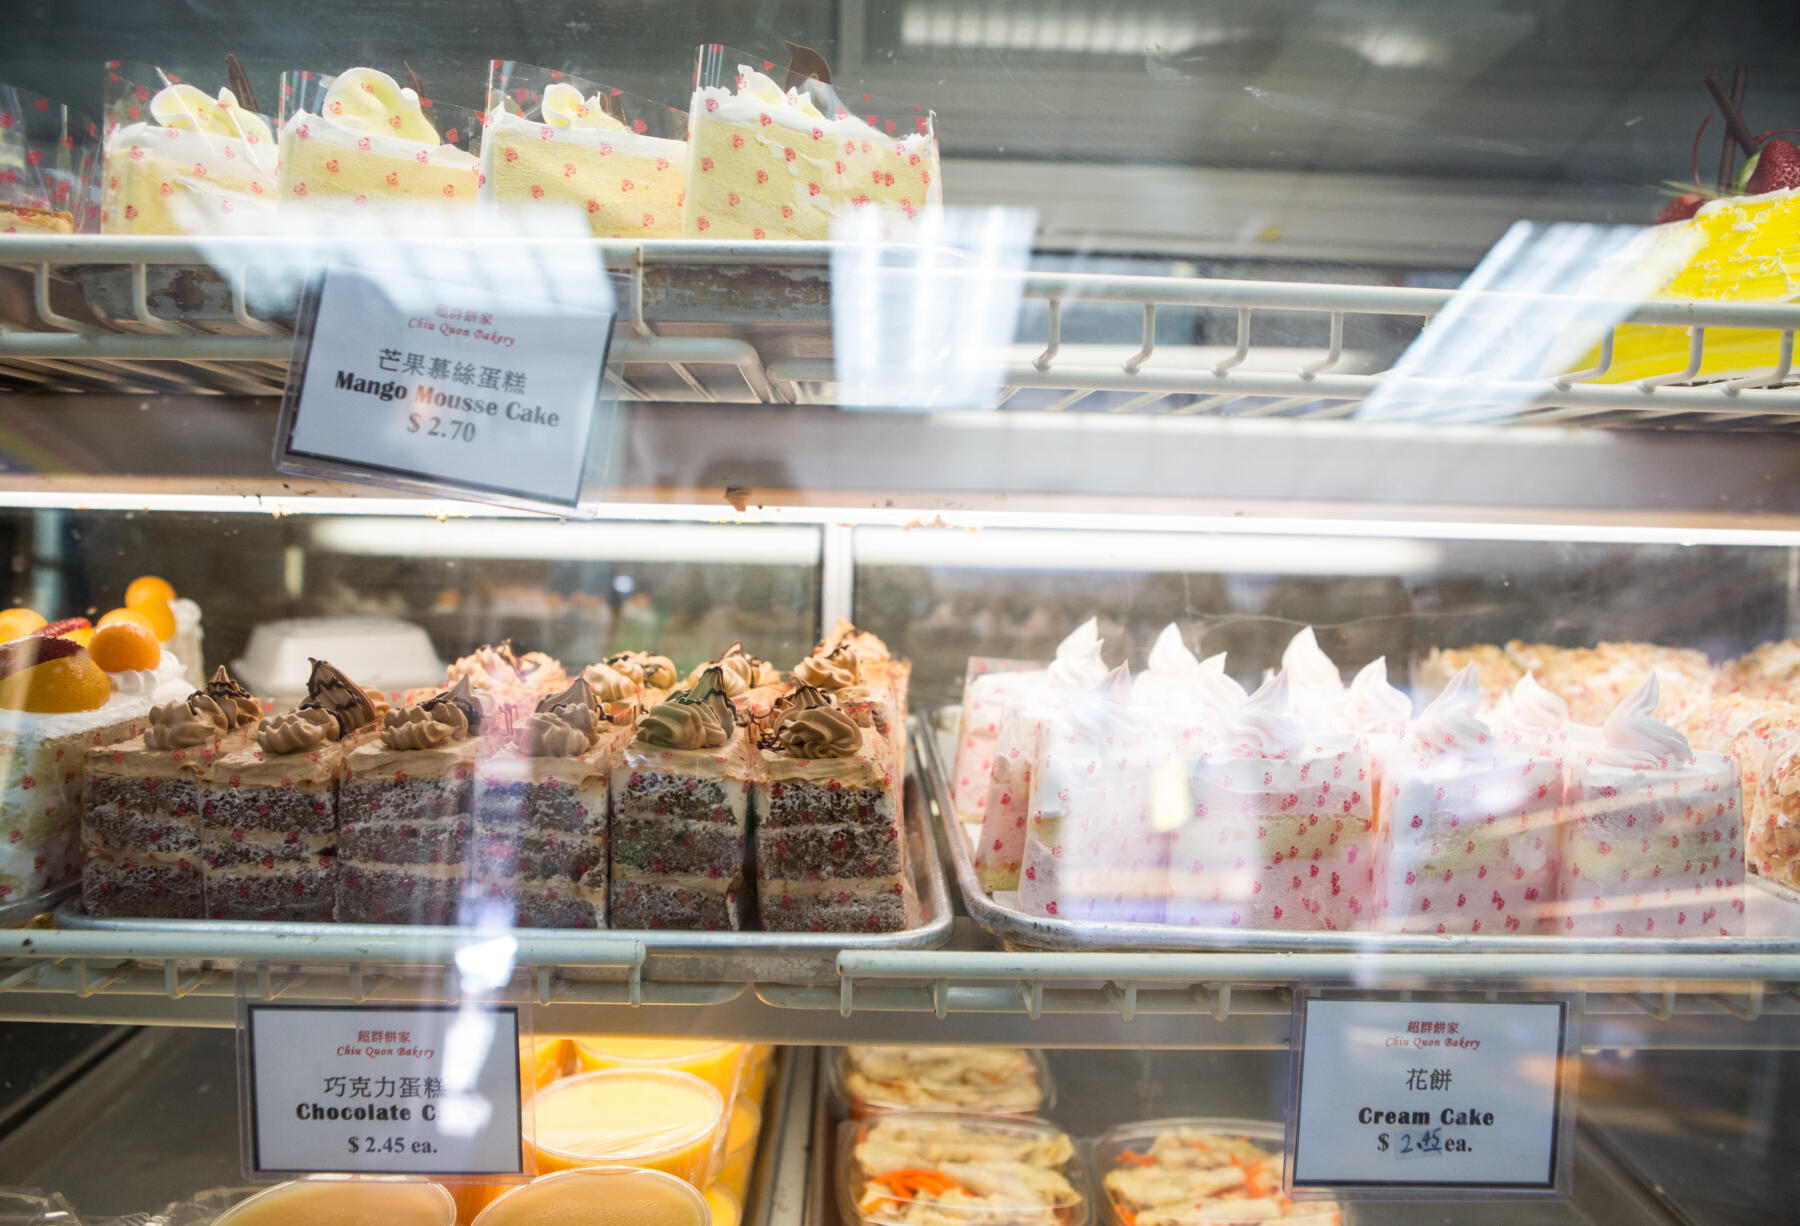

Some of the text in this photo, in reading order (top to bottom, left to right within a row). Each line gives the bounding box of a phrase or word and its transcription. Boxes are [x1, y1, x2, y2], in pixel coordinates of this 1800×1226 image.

[408, 317, 516, 346] Chiu Quon Bakery
[378, 348, 526, 394] 芒果慕絲蛋糕
[335, 371, 560, 427] Mango Mousse Cake
[427, 416, 476, 443] 2.70
[358, 1030, 411, 1043] 超群餅家
[1407, 1021, 1460, 1034] 超群餅家
[337, 1046, 435, 1058] Chiu Quon Bakery
[1384, 1036, 1480, 1050] Chiu Quon Bakery
[323, 1076, 446, 1098] 巧克力蛋糕
[1406, 1068, 1452, 1091] 花餅
[296, 1103, 411, 1121] Chocolate
[1358, 1107, 1494, 1126] Cream Cake
[366, 1137, 405, 1153] 2.45
[412, 1140, 438, 1153] ea.
